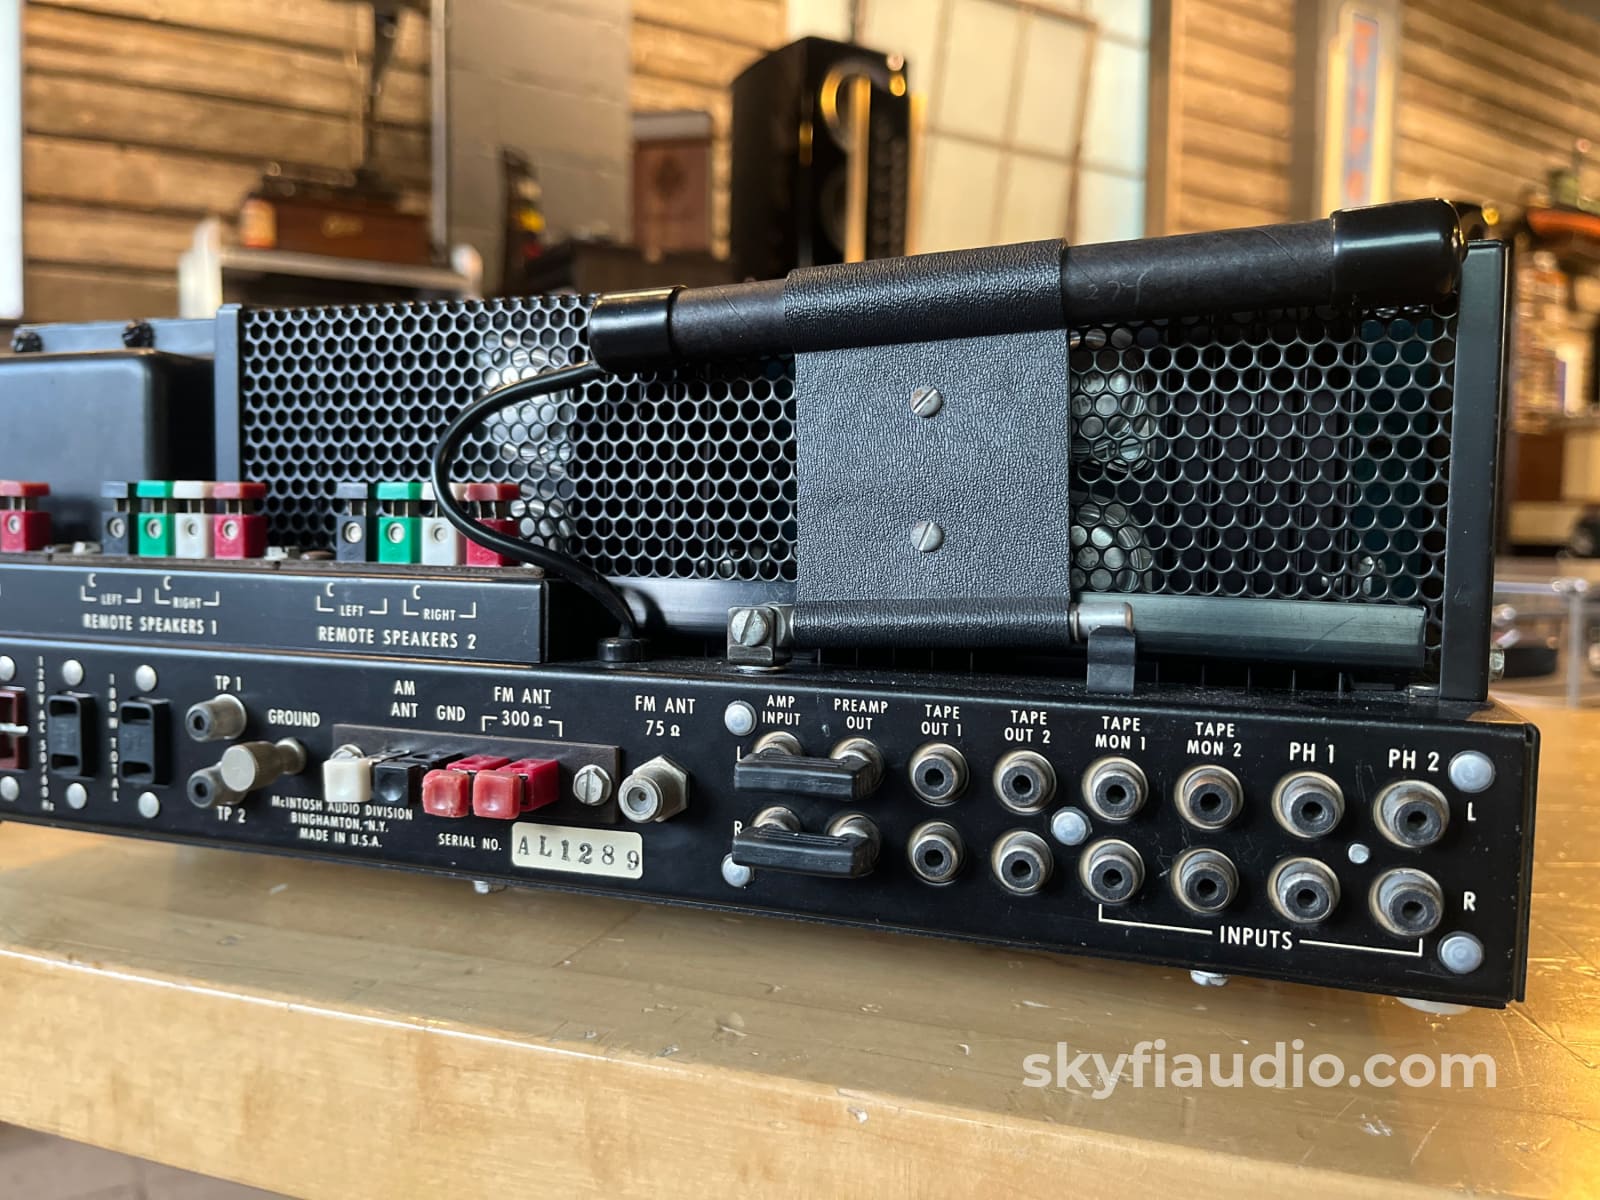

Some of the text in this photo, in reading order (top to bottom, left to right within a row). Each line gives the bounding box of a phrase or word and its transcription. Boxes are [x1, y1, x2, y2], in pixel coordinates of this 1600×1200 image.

[88, 573, 97, 588] C
[163, 575, 172, 591] C
[326, 582, 335, 597] C
[412, 584, 421, 600] C
[100, 593, 123, 606] LEFT
[172, 596, 202, 609] RIGHT
[340, 605, 364, 617] LEFT
[423, 608, 456, 621] RIGHT
[82, 613, 218, 635] REMOTE SPEAKERS 1
[318, 626, 477, 650] REMOTE SPEAKERS 2
[214, 674, 242, 691] TP 1
[394, 679, 416, 696] AM
[494, 686, 552, 705] FM ANT
[766, 694, 796, 709] AMP
[390, 702, 419, 718] ANT
[634, 695, 696, 714] FM ANT
[833, 698, 889, 714] PREAMP
[924, 704, 960, 720] TAPE
[268, 709, 320, 728] GROUND
[436, 705, 466, 722] GND
[762, 710, 801, 726] INPUT
[1010, 710, 1048, 726] TAPE
[846, 716, 873, 731] OUT
[921, 721, 962, 737] OUT 1
[1101, 716, 1142, 732] TAPE
[1195, 721, 1235, 738] TAPE
[1004, 727, 1051, 744] OUT 2
[1095, 734, 1146, 751] MON 1
[1187, 740, 1242, 757] MON 2
[1289, 742, 1335, 764] PH 1
[1388, 748, 1440, 771] PH 2
[216, 805, 246, 823] TP 2
[271, 795, 413, 820] McINTOSH AUDIO DIVISION
[1466, 802, 1477, 821] L
[290, 811, 389, 832] BINGHAMTON, N.Y.
[299, 827, 383, 848] MADE IN U.S.A.
[438, 833, 502, 851] SERIAL NO.
[1463, 891, 1476, 911] R
[1219, 925, 1293, 950] INPUTS
